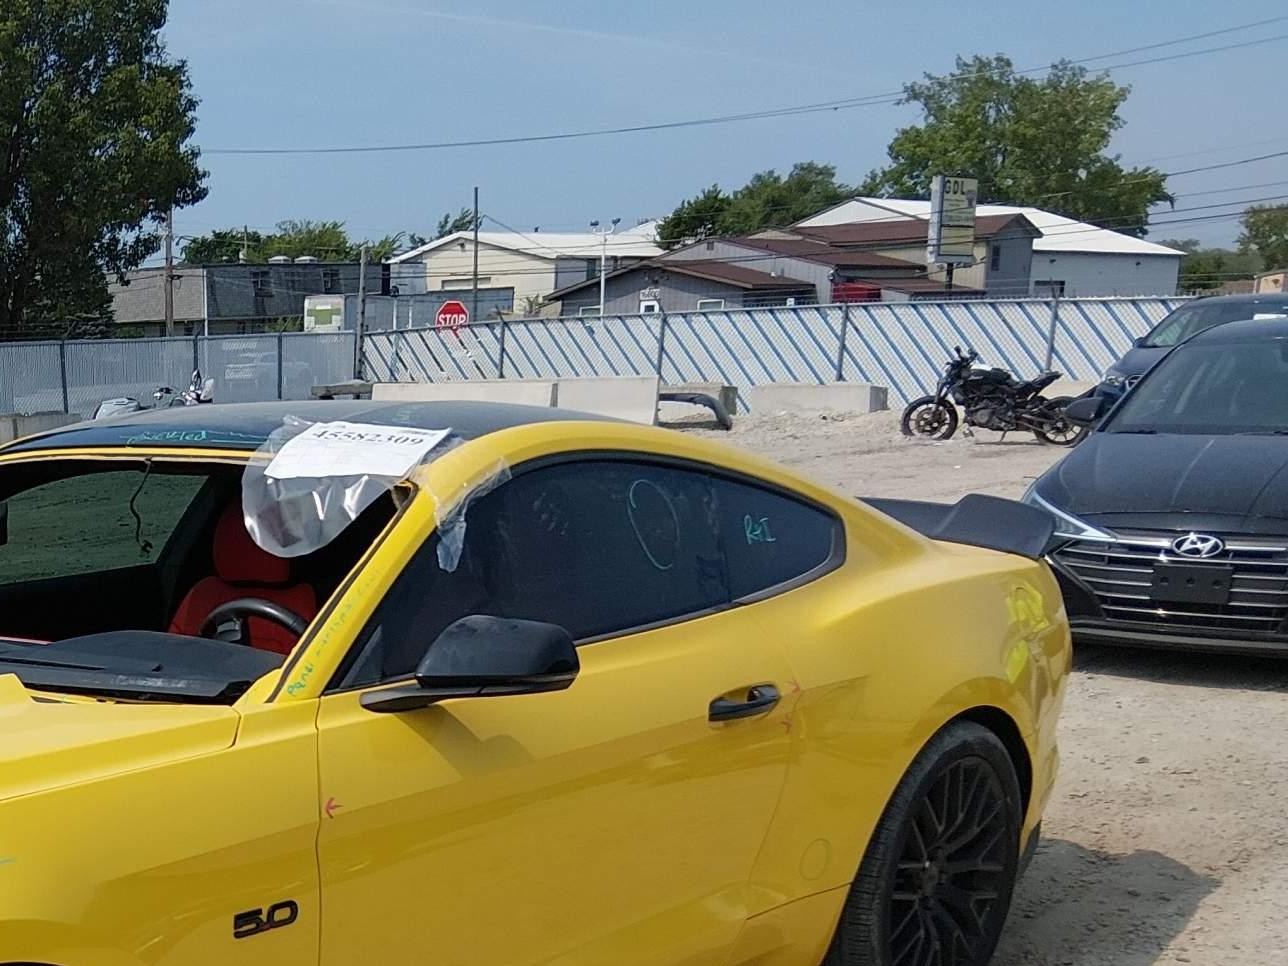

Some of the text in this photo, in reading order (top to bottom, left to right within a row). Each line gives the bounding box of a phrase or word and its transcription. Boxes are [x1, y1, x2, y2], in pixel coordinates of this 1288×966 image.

[438, 313, 467, 327] STOP
[313, 429, 425, 446] 45582309
[233, 899, 299, 940] 5.0
